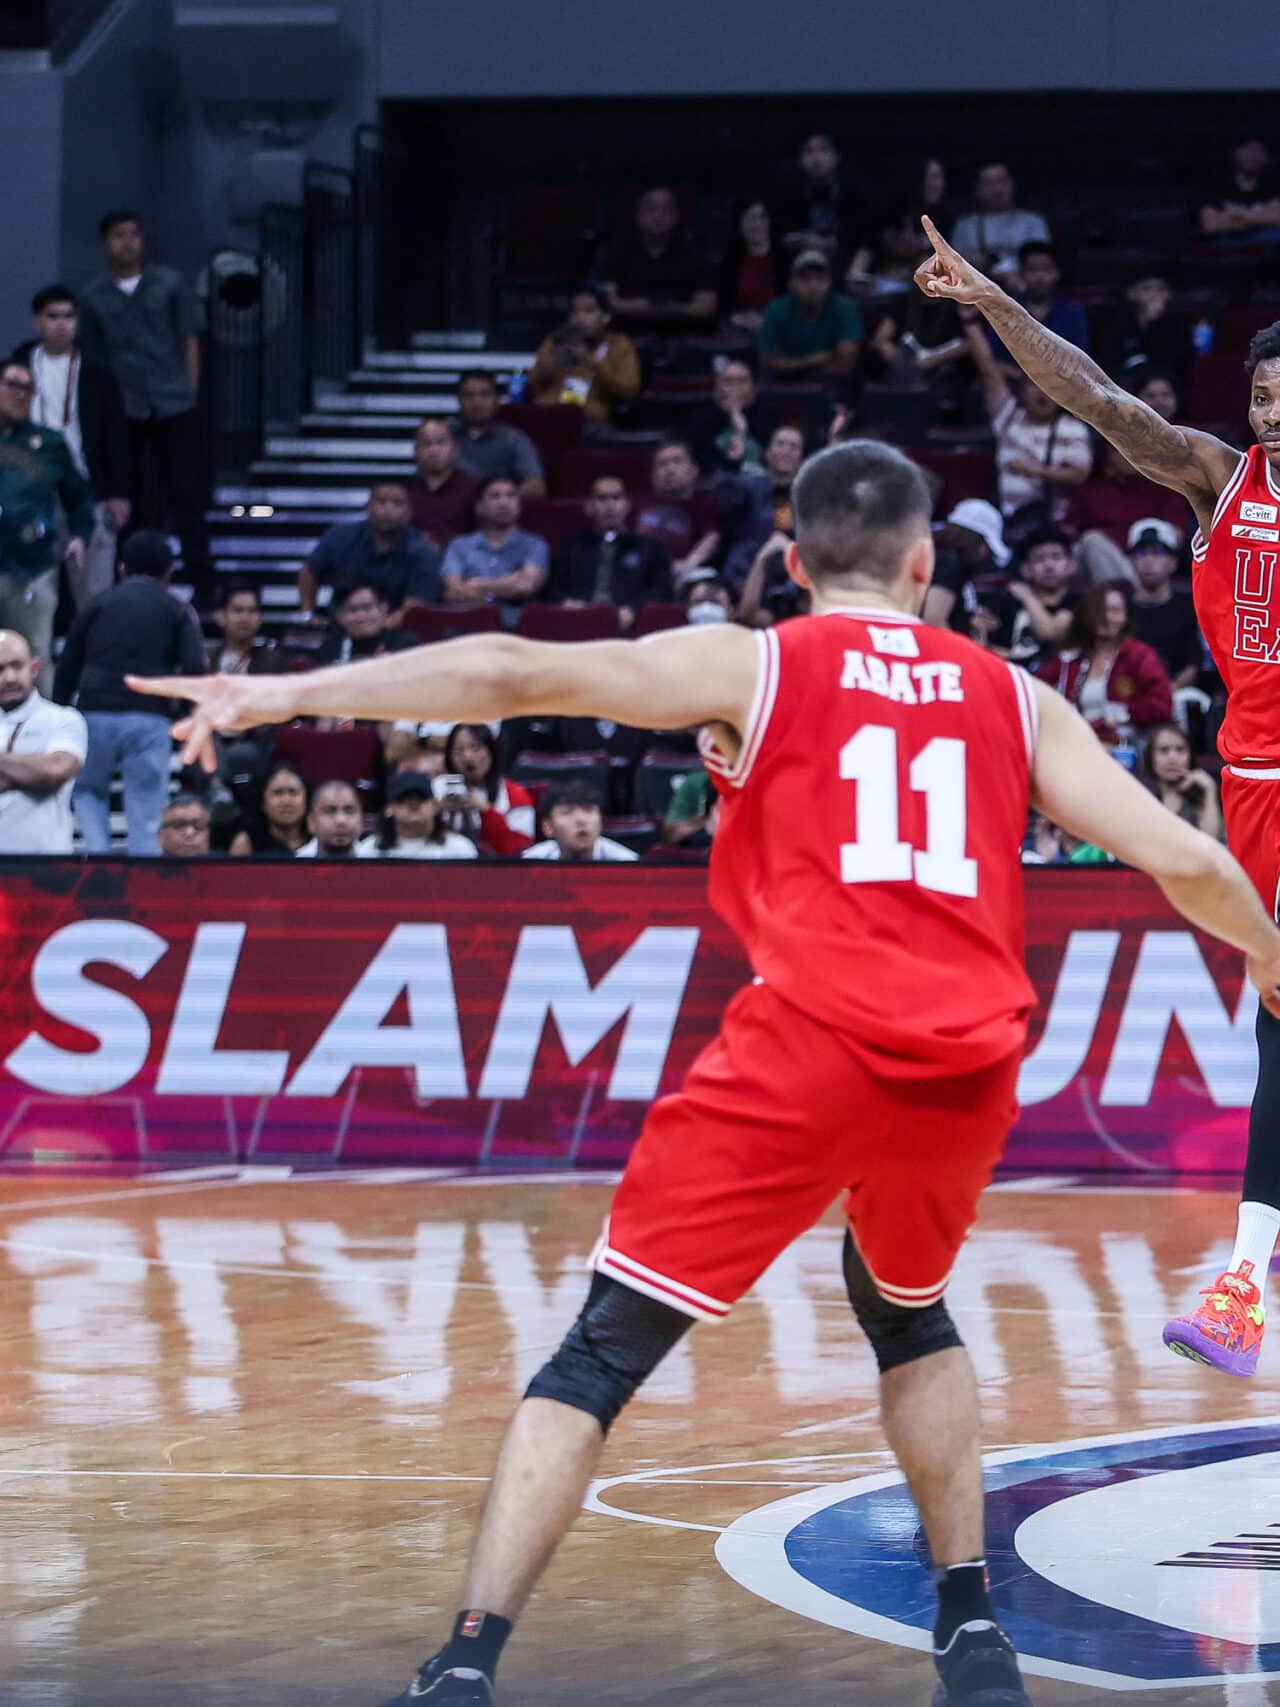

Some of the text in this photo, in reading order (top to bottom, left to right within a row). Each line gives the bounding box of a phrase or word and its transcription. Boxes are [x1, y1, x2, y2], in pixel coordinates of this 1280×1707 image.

[839, 649, 965, 705] ABATE
[839, 723, 979, 899] 11
[4, 919, 700, 1100] SLAM
